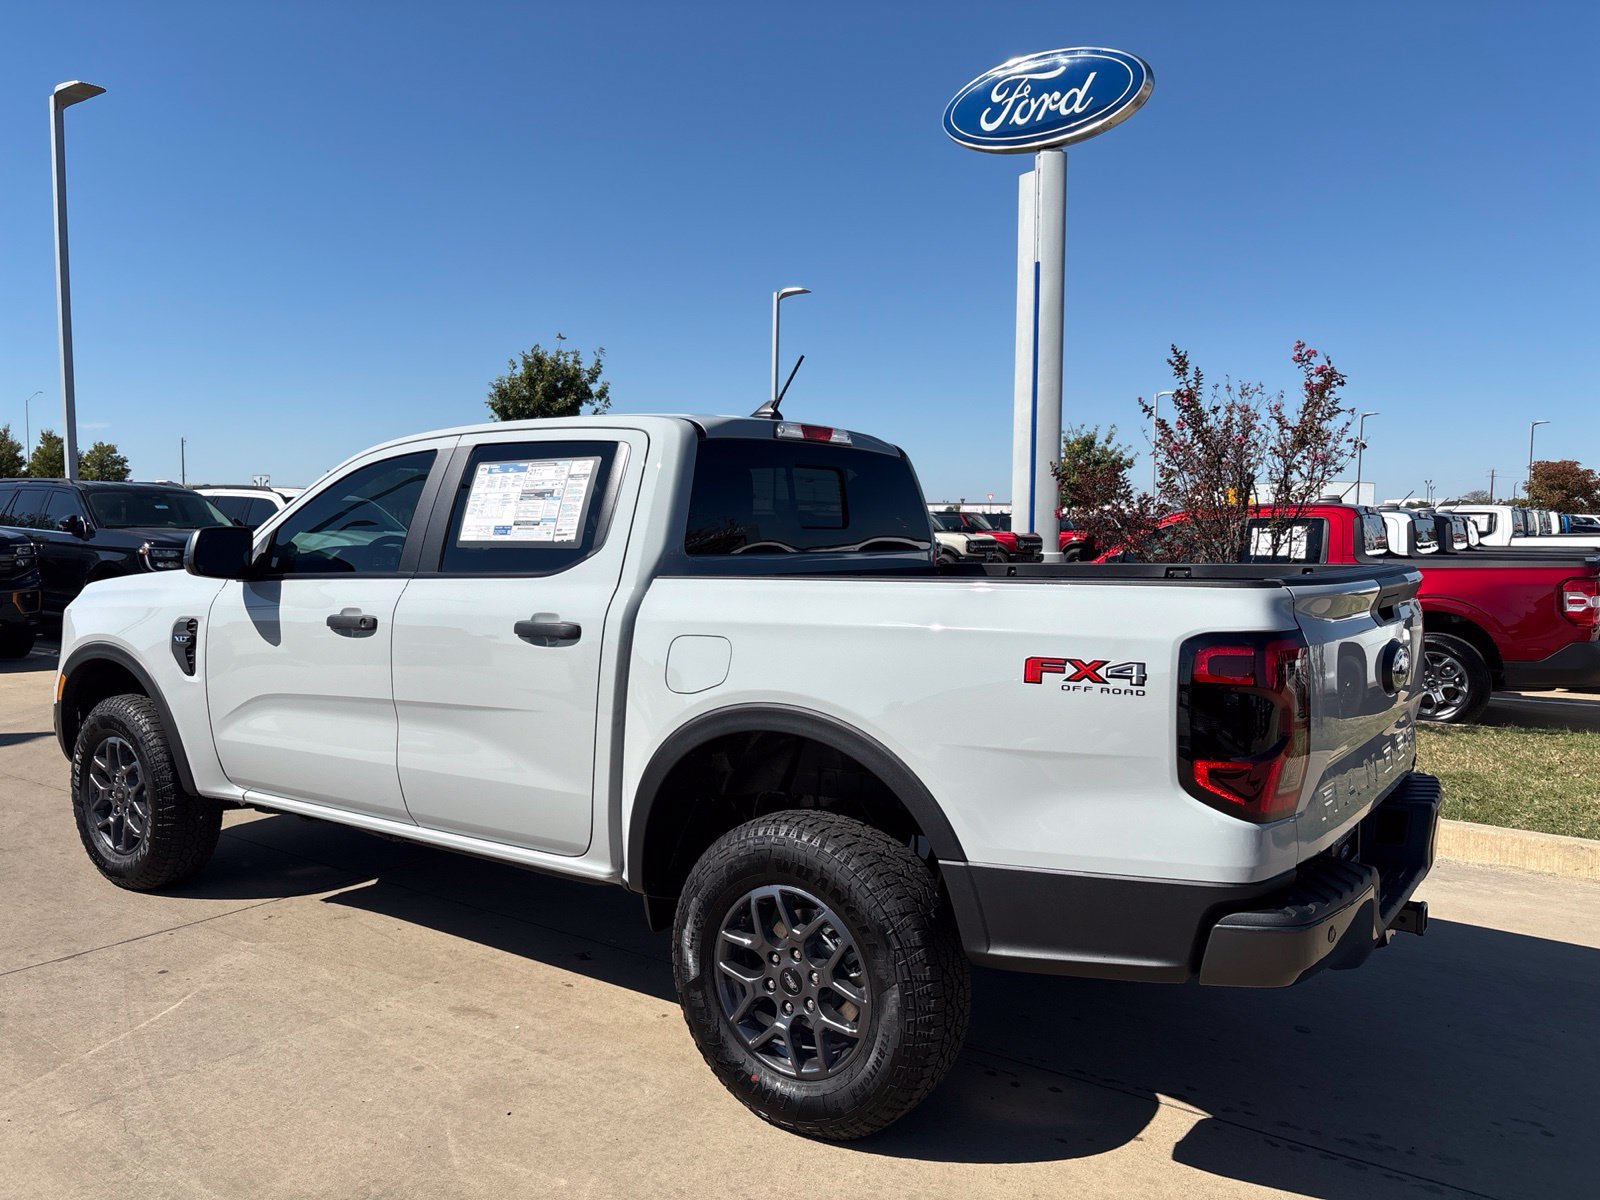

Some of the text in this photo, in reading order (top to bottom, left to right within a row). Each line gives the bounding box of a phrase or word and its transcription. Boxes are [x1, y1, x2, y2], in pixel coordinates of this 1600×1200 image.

[979, 65, 1098, 132] Ford
[1023, 656, 1148, 687] FX4
[1061, 684, 1146, 697] OFF ROAD
